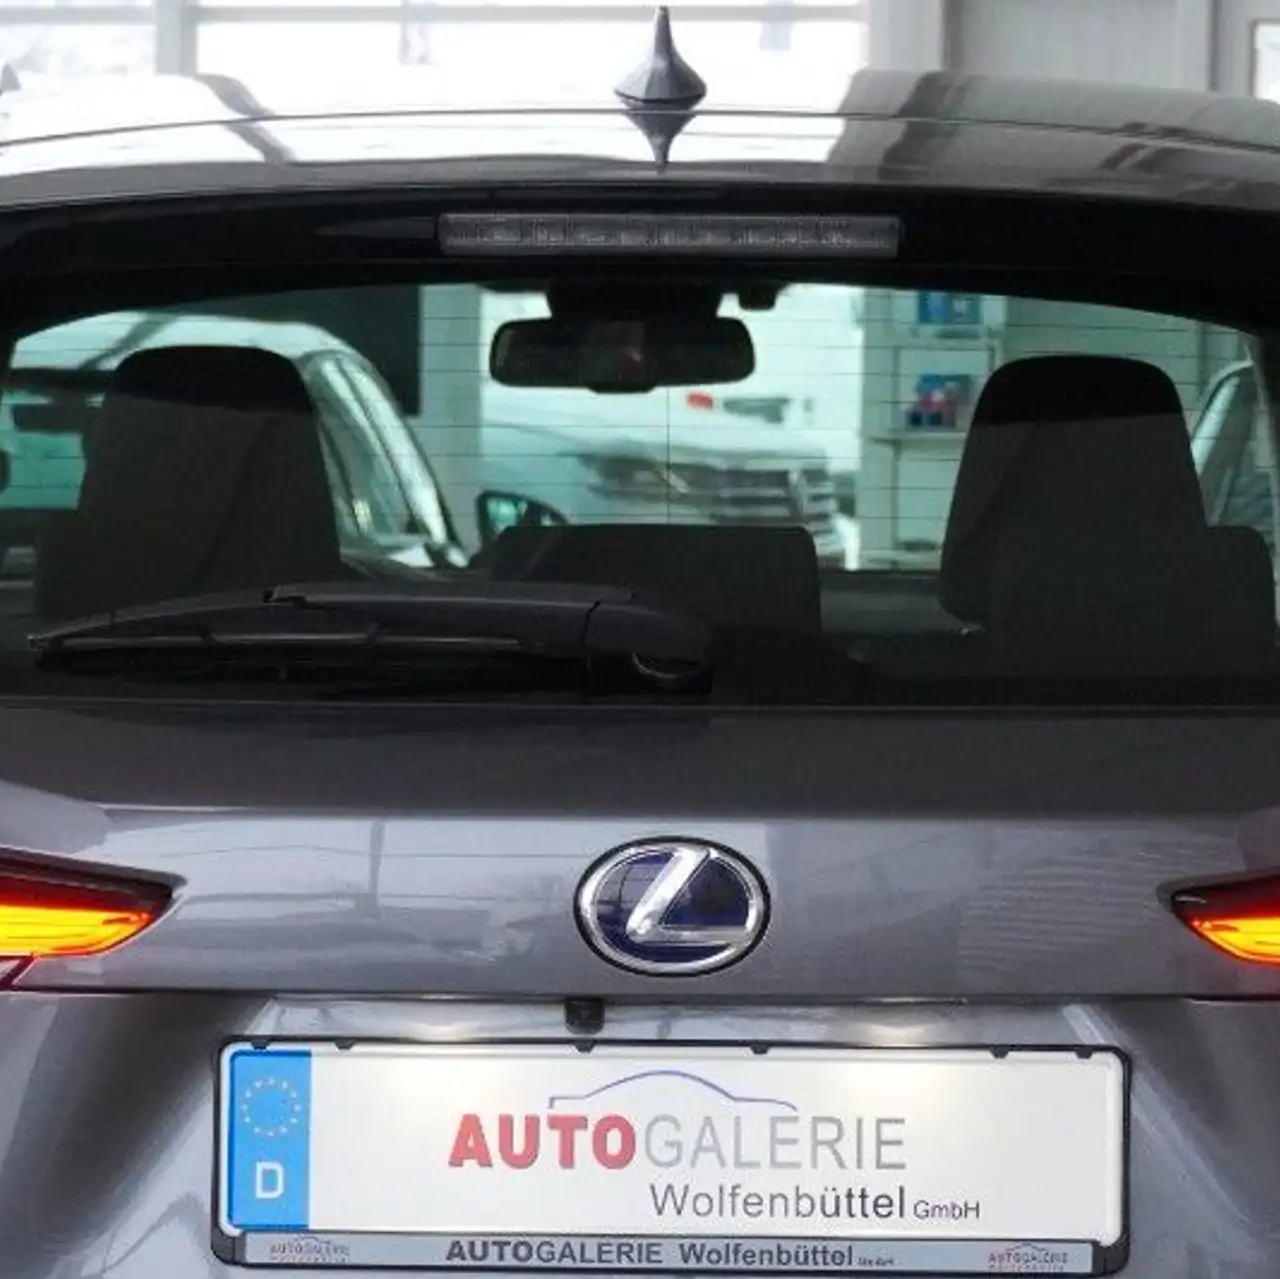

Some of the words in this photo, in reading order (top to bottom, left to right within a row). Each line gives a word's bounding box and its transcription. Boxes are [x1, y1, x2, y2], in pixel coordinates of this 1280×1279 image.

[447, 1112, 908, 1170] AUTOGALERIE
[255, 1160, 284, 1200] D
[649, 1182, 905, 1220] Wolfenbüttel
[912, 1199, 981, 1221] GmbH
[445, 1239, 663, 1264] AUTOGALERIE
[678, 1242, 853, 1267] Wolfenbüttel
